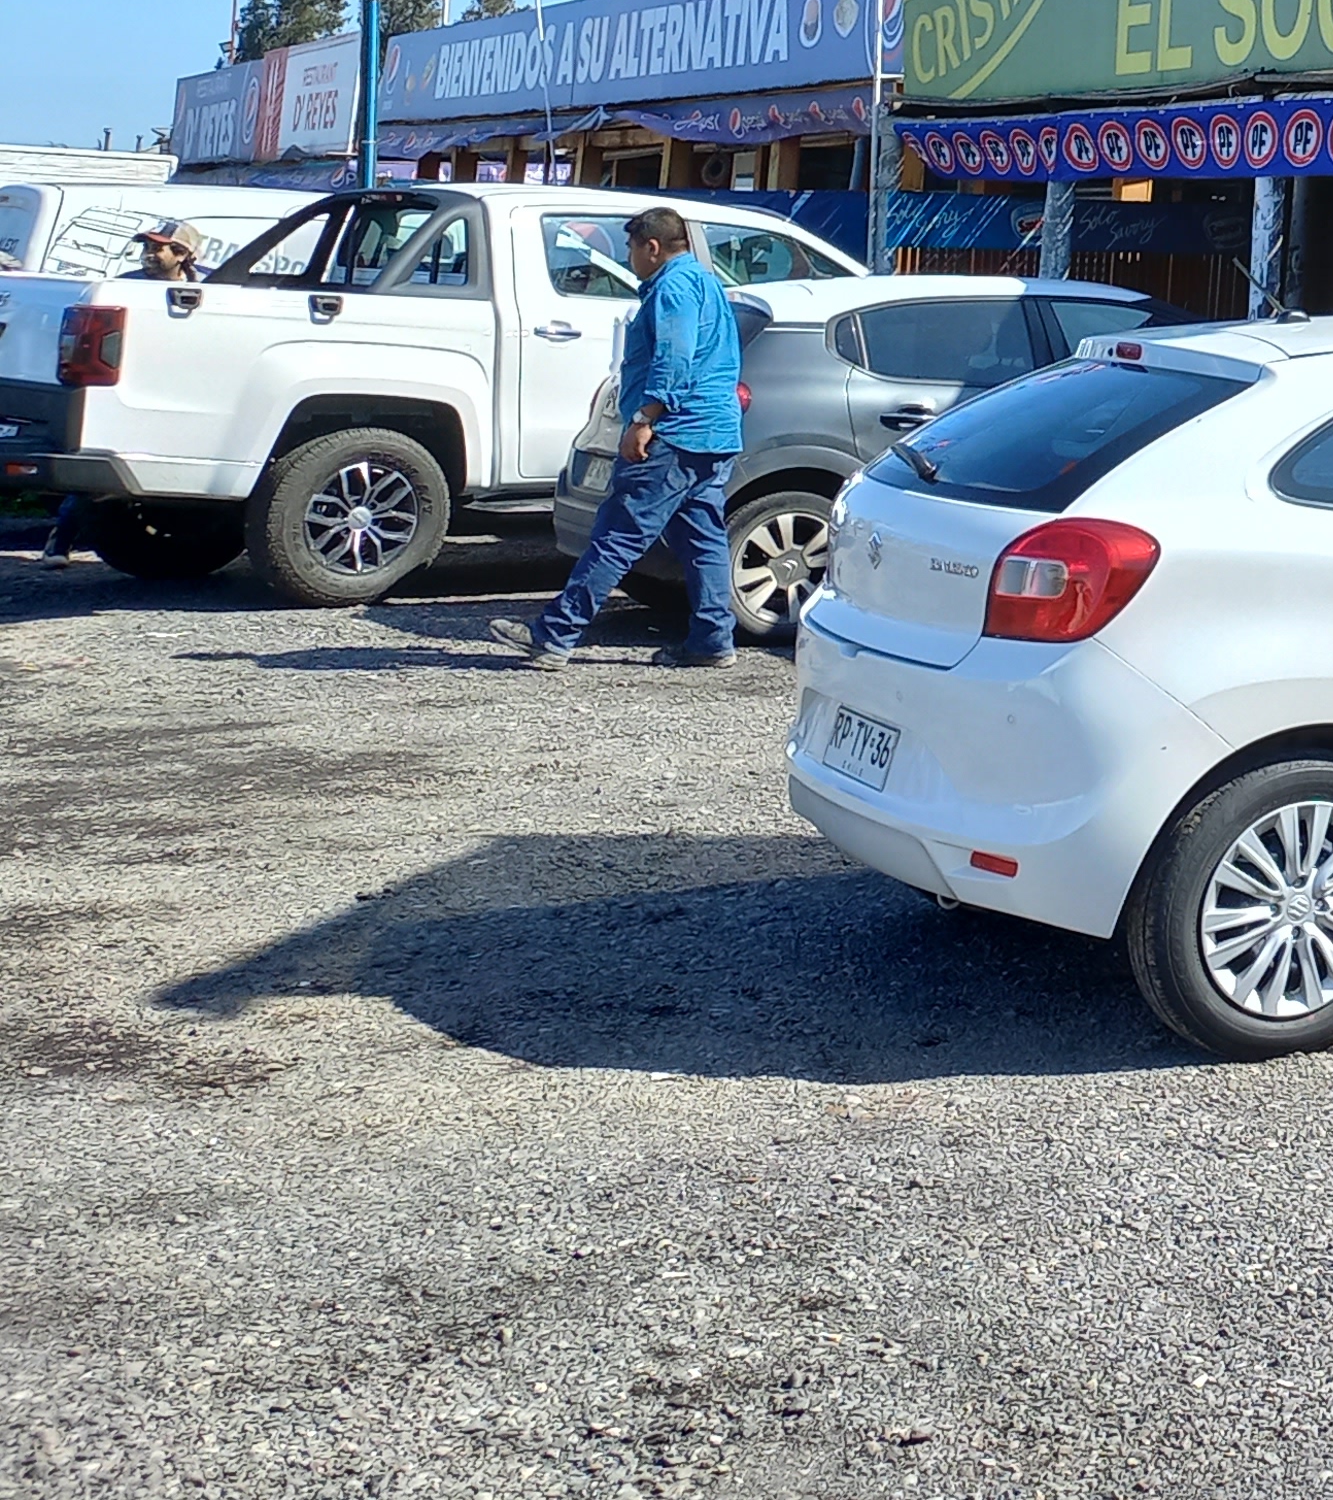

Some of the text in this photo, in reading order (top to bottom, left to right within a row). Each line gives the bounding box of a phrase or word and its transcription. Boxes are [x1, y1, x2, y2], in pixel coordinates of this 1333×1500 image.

[435, 24, 556, 99] BIENVENIDOS
[556, 22, 576, 86] A
[576, 15, 610, 84] SU
[1074, 135, 1090, 159] PF
[1107, 132, 1123, 159] PF
[1144, 131, 1159, 158] PF
[1180, 127, 1196, 155] PF
[1220, 124, 1234, 151] PF
[1252, 122, 1268, 154] PF
[1294, 119, 1313, 155] PF
